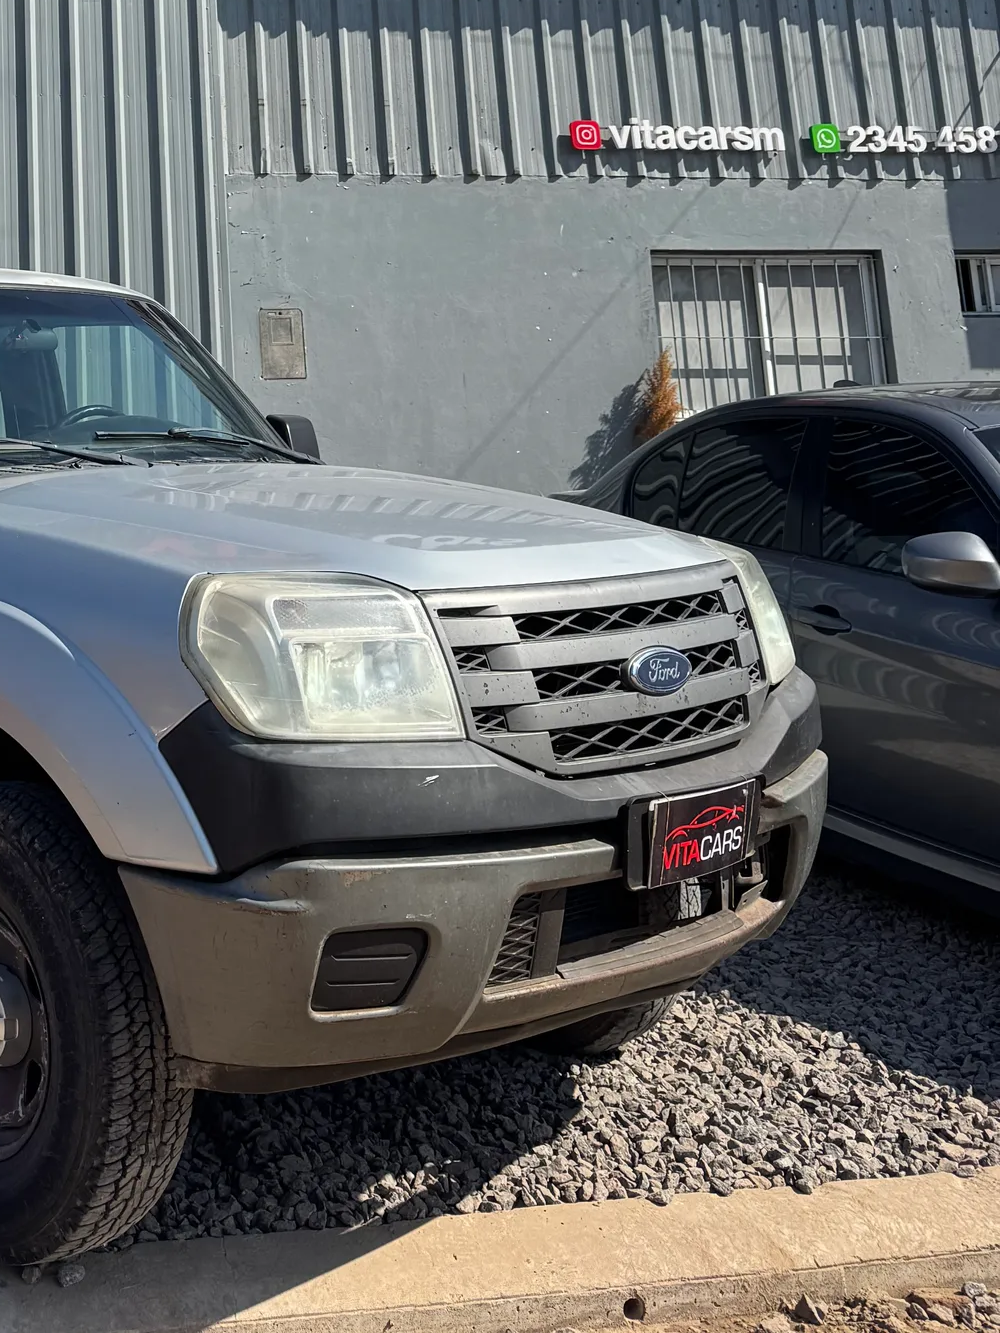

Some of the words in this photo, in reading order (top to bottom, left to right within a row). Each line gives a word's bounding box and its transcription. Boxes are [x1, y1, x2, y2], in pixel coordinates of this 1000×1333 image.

[608, 117, 786, 152] vitacarsm
[846, 125, 927, 153] 2345
[935, 125, 999, 154] 458
[648, 656, 681, 682] Ford
[662, 825, 743, 870] VITACARS
